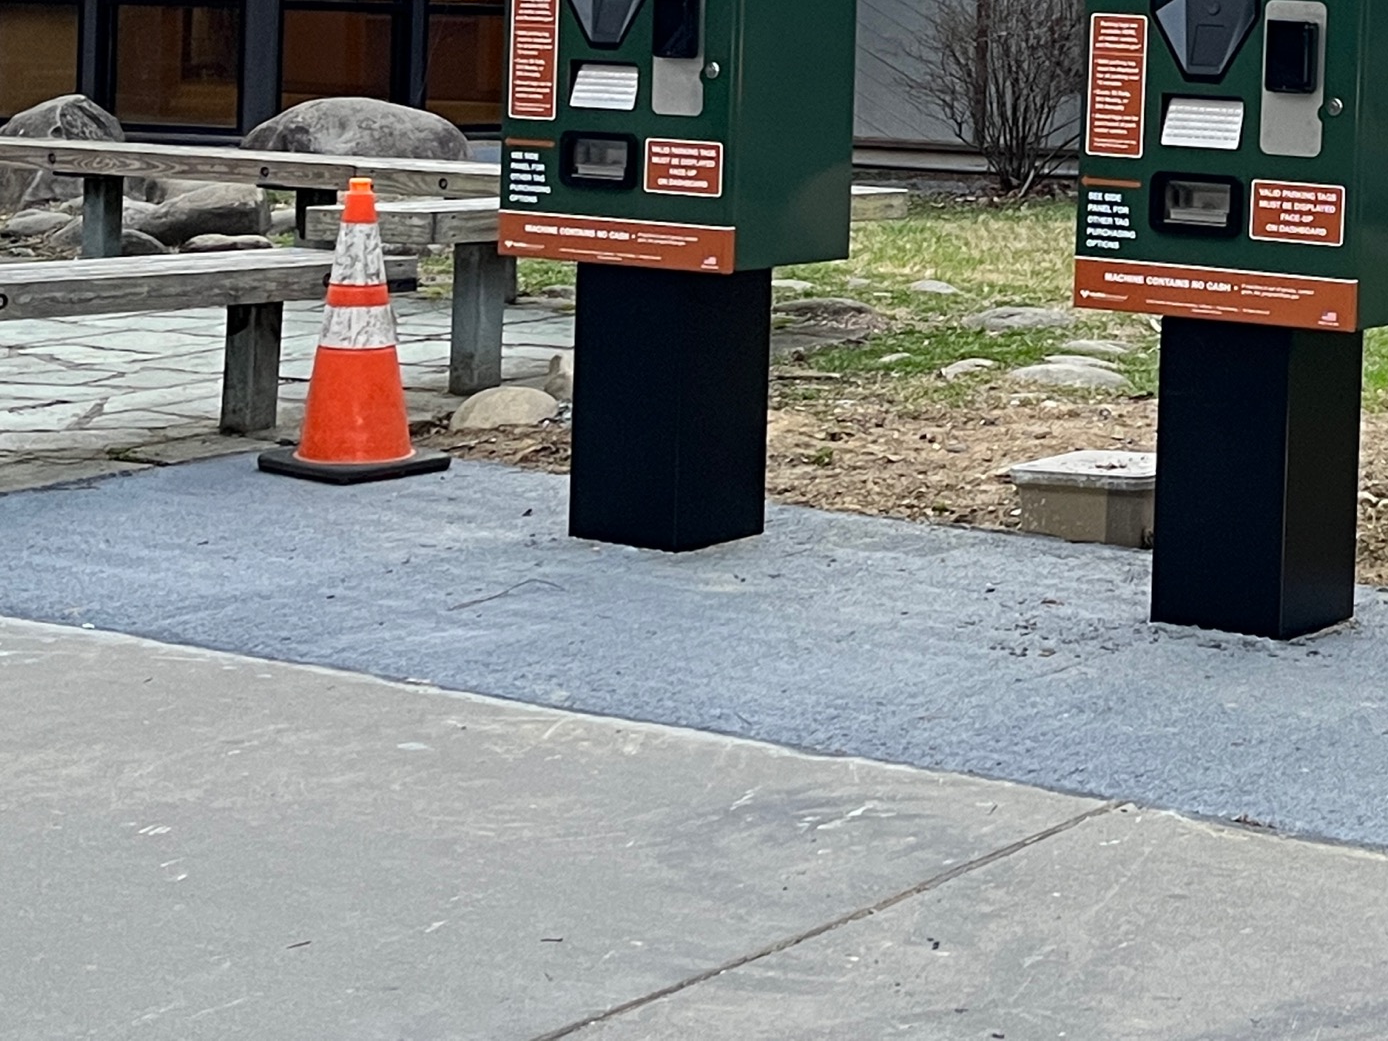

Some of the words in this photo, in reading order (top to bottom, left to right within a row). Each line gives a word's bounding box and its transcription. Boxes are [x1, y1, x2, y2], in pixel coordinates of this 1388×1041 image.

[1259, 188, 1281, 197] VALID
[1282, 190, 1316, 200] PARKING
[1317, 192, 1336, 201] TAGS
[1259, 200, 1281, 208] MUST
[1282, 201, 1292, 210] BE
[1293, 202, 1336, 213] DISPLAYED
[1280, 213, 1314, 223] FACE-UP
[1265, 223, 1278, 231] ON
[1279, 224, 1327, 236] DASHBOARD
[1104, 272, 1144, 284] MACHINE
[1146, 276, 1190, 288] CONTAINS
[1191, 280, 1205, 289] NO
[1206, 281, 1231, 292] CASH
